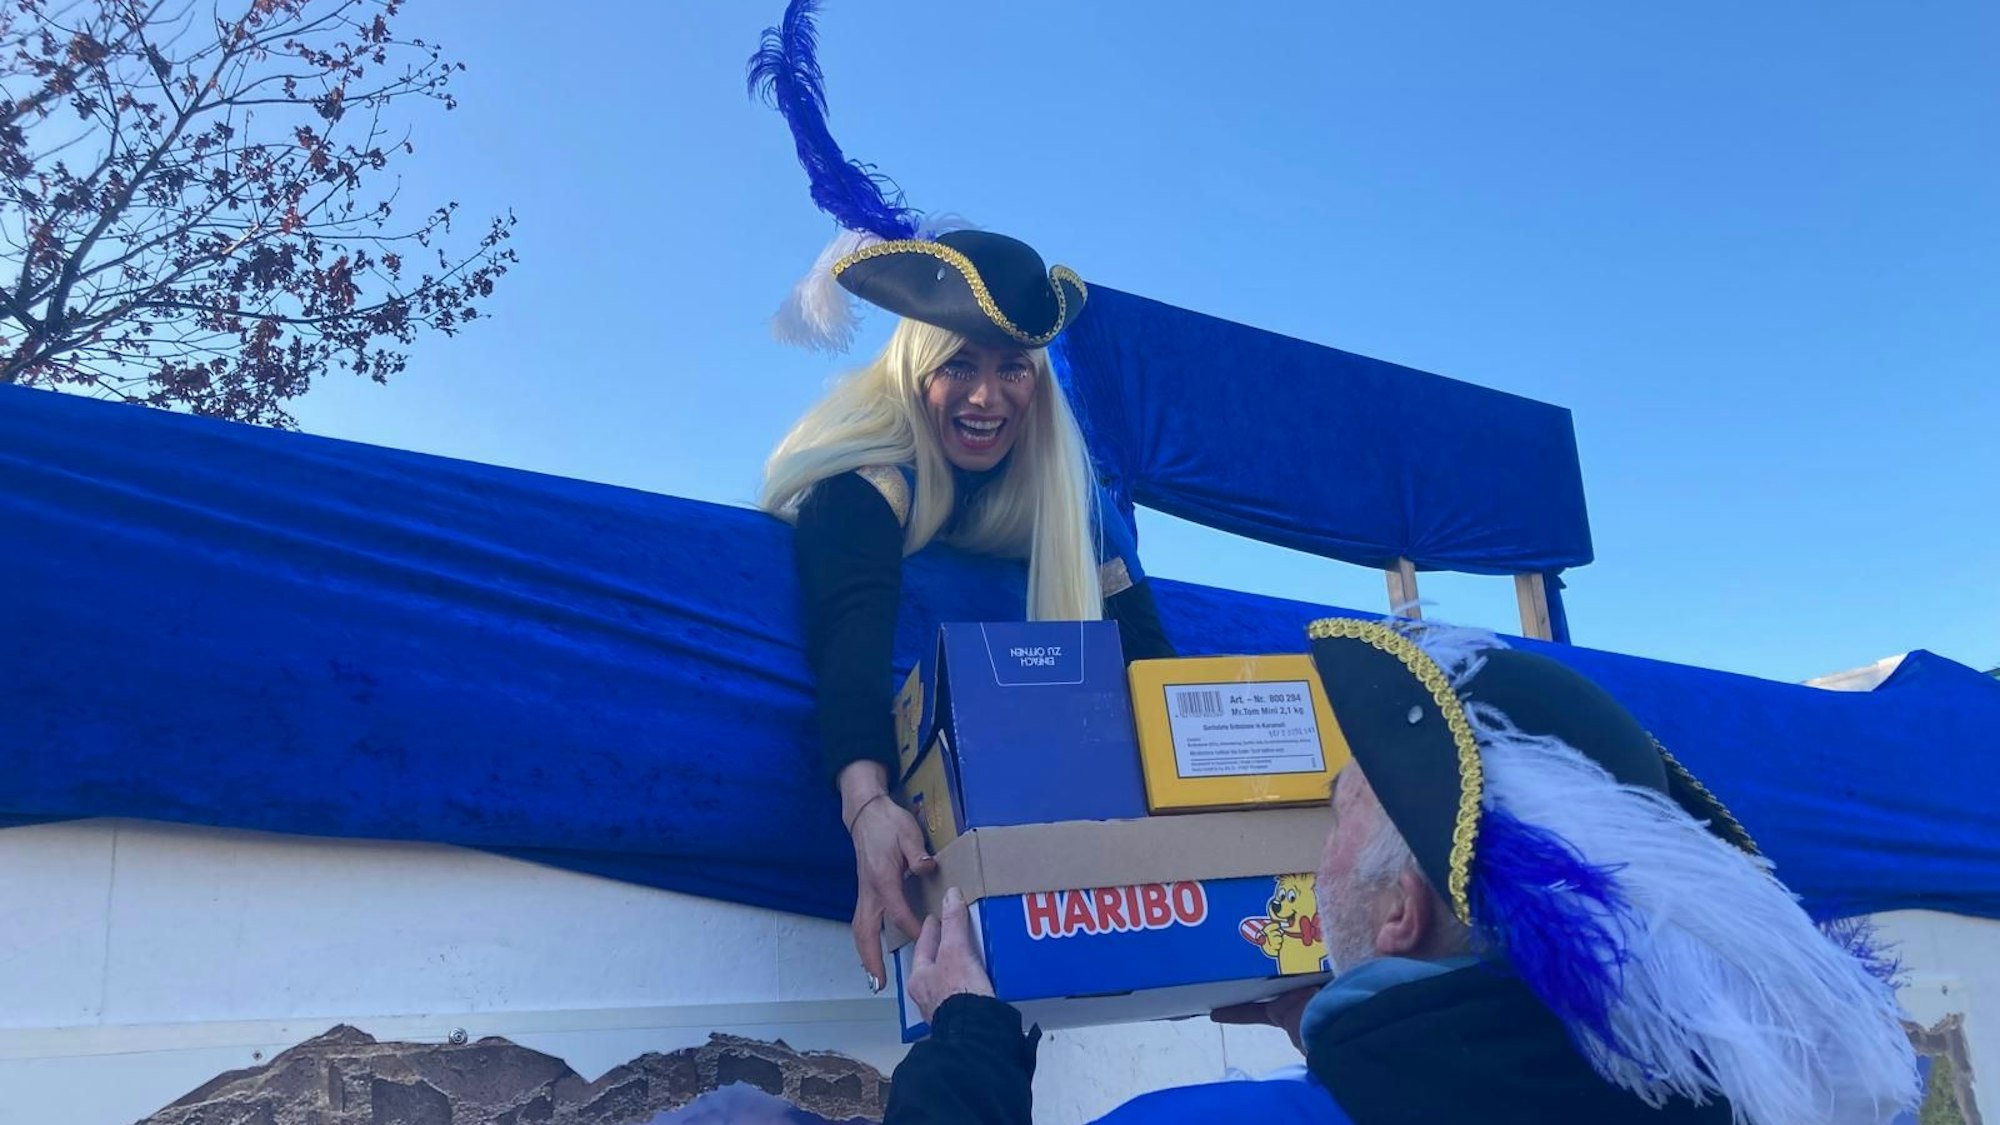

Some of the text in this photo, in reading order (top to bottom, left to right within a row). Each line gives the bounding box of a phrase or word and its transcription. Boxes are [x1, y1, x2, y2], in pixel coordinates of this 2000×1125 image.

[1047, 646, 1062, 656] ZU
[1020, 657, 1055, 667] EINFACH
[1229, 694, 1244, 704] Art.
[1253, 693, 1265, 703] Nr.
[1269, 693, 1284, 703] 800
[1261, 706, 1278, 715] Mini
[1279, 706, 1291, 715] 2,1
[1293, 706, 1304, 715] kg
[1025, 880, 1206, 937] HARIBO
